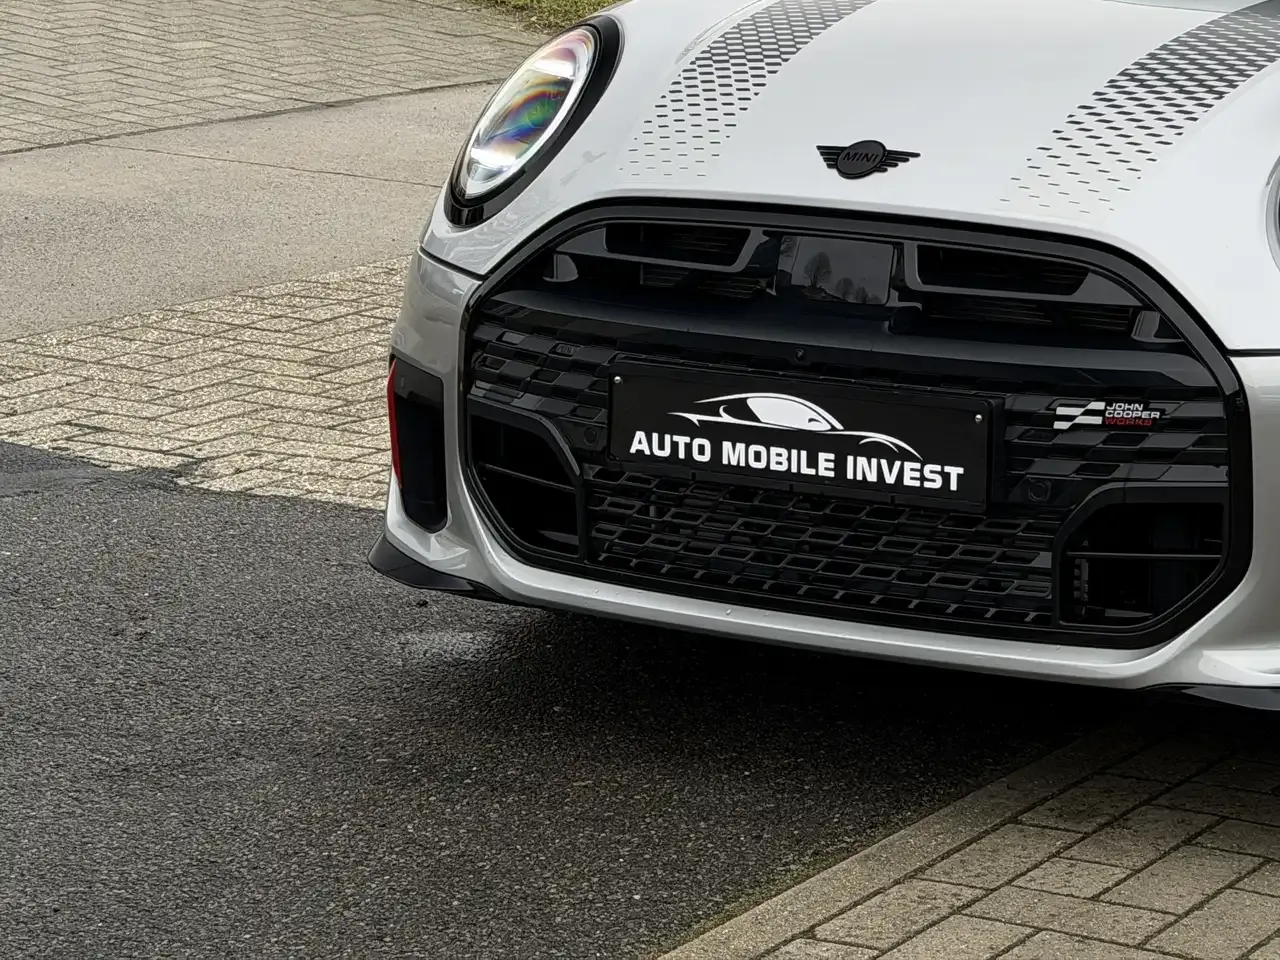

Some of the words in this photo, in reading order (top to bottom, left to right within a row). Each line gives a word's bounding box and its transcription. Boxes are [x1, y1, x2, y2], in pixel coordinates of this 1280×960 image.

[843, 151, 880, 163] MINI
[1106, 402, 1144, 411] JOHN
[1105, 410, 1160, 419] COOPER
[1104, 418, 1152, 426] WORKS
[630, 430, 711, 462] AUTO
[722, 441, 835, 477] MOBILE
[846, 455, 964, 491] INVEST
